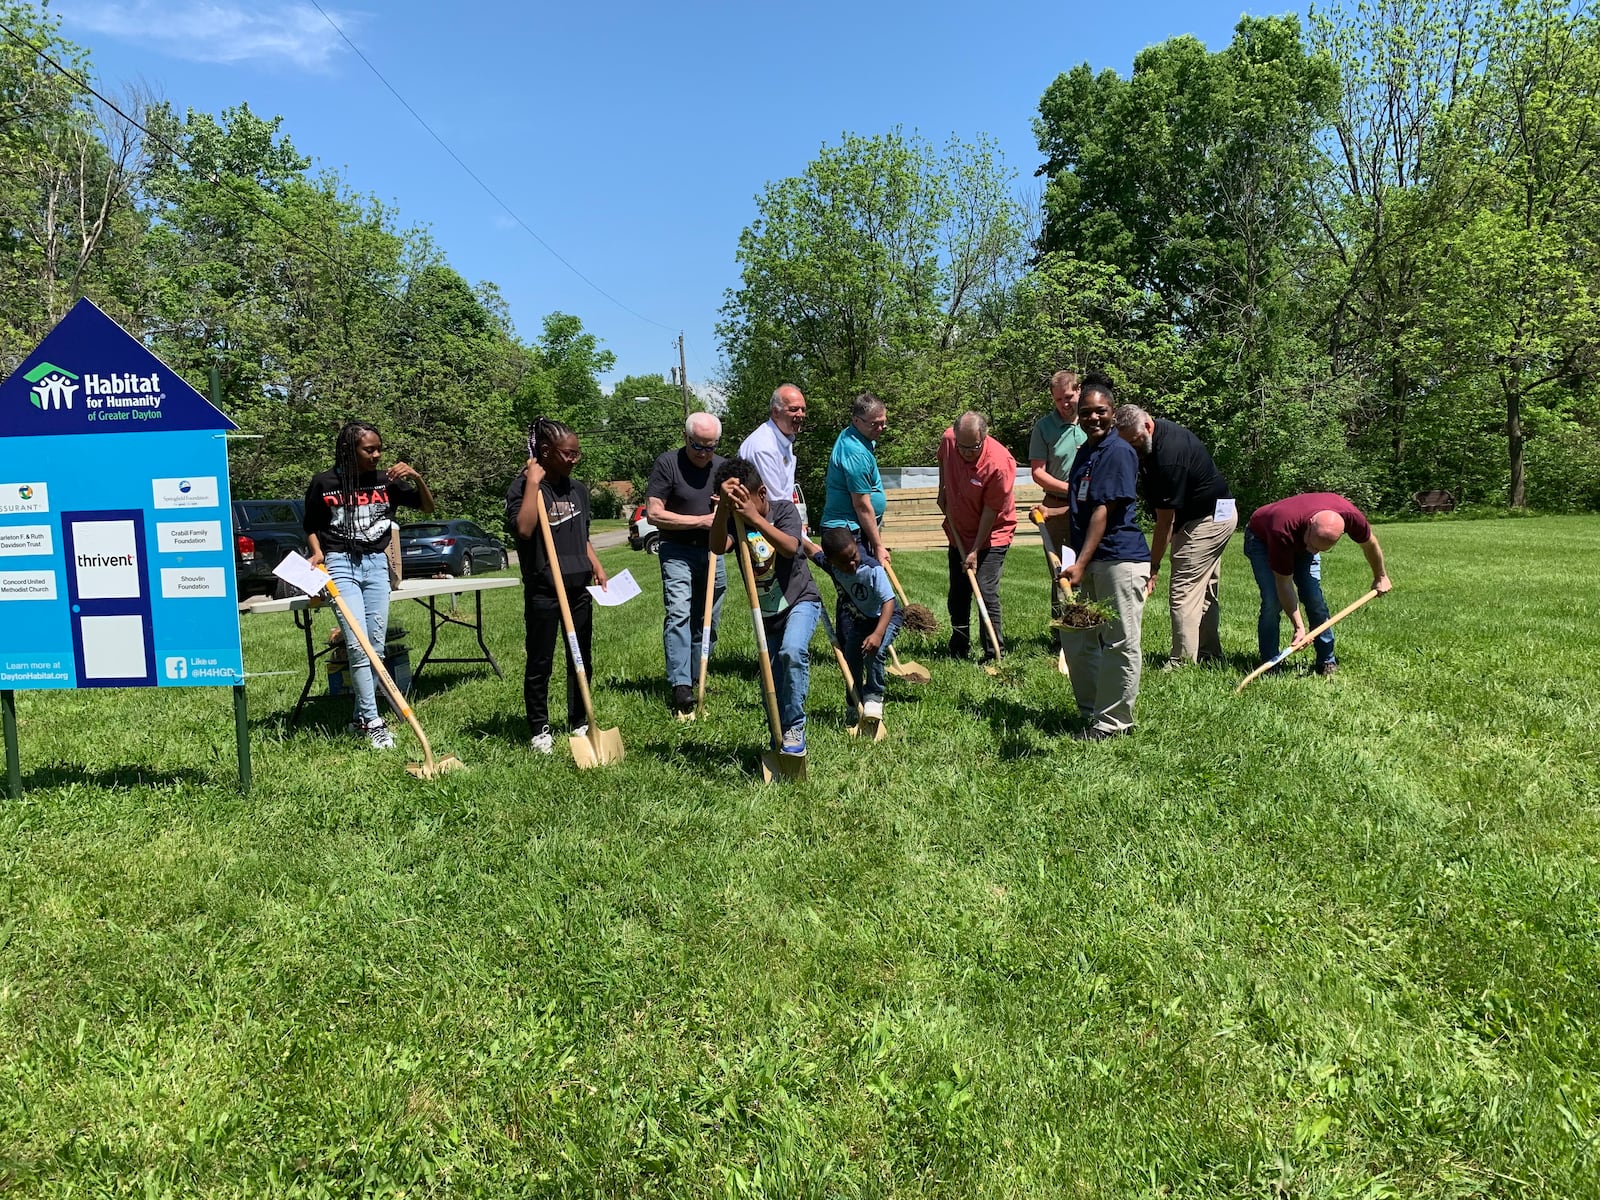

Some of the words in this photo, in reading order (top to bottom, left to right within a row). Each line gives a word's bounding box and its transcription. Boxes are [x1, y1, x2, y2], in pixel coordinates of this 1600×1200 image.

[84, 373, 160, 395] Habitat
[86, 397, 103, 408] for
[106, 395, 161, 408] Humanity
[88, 411, 96, 421] of
[98, 410, 130, 421] Greater
[132, 410, 162, 421] Dayton
[78, 553, 133, 567] thrivent
[5, 662, 29, 670] Learn
[53, 661, 61, 669] at
[191, 657, 207, 665] Like
[0, 671, 69, 681] DaytonHabitat.org
